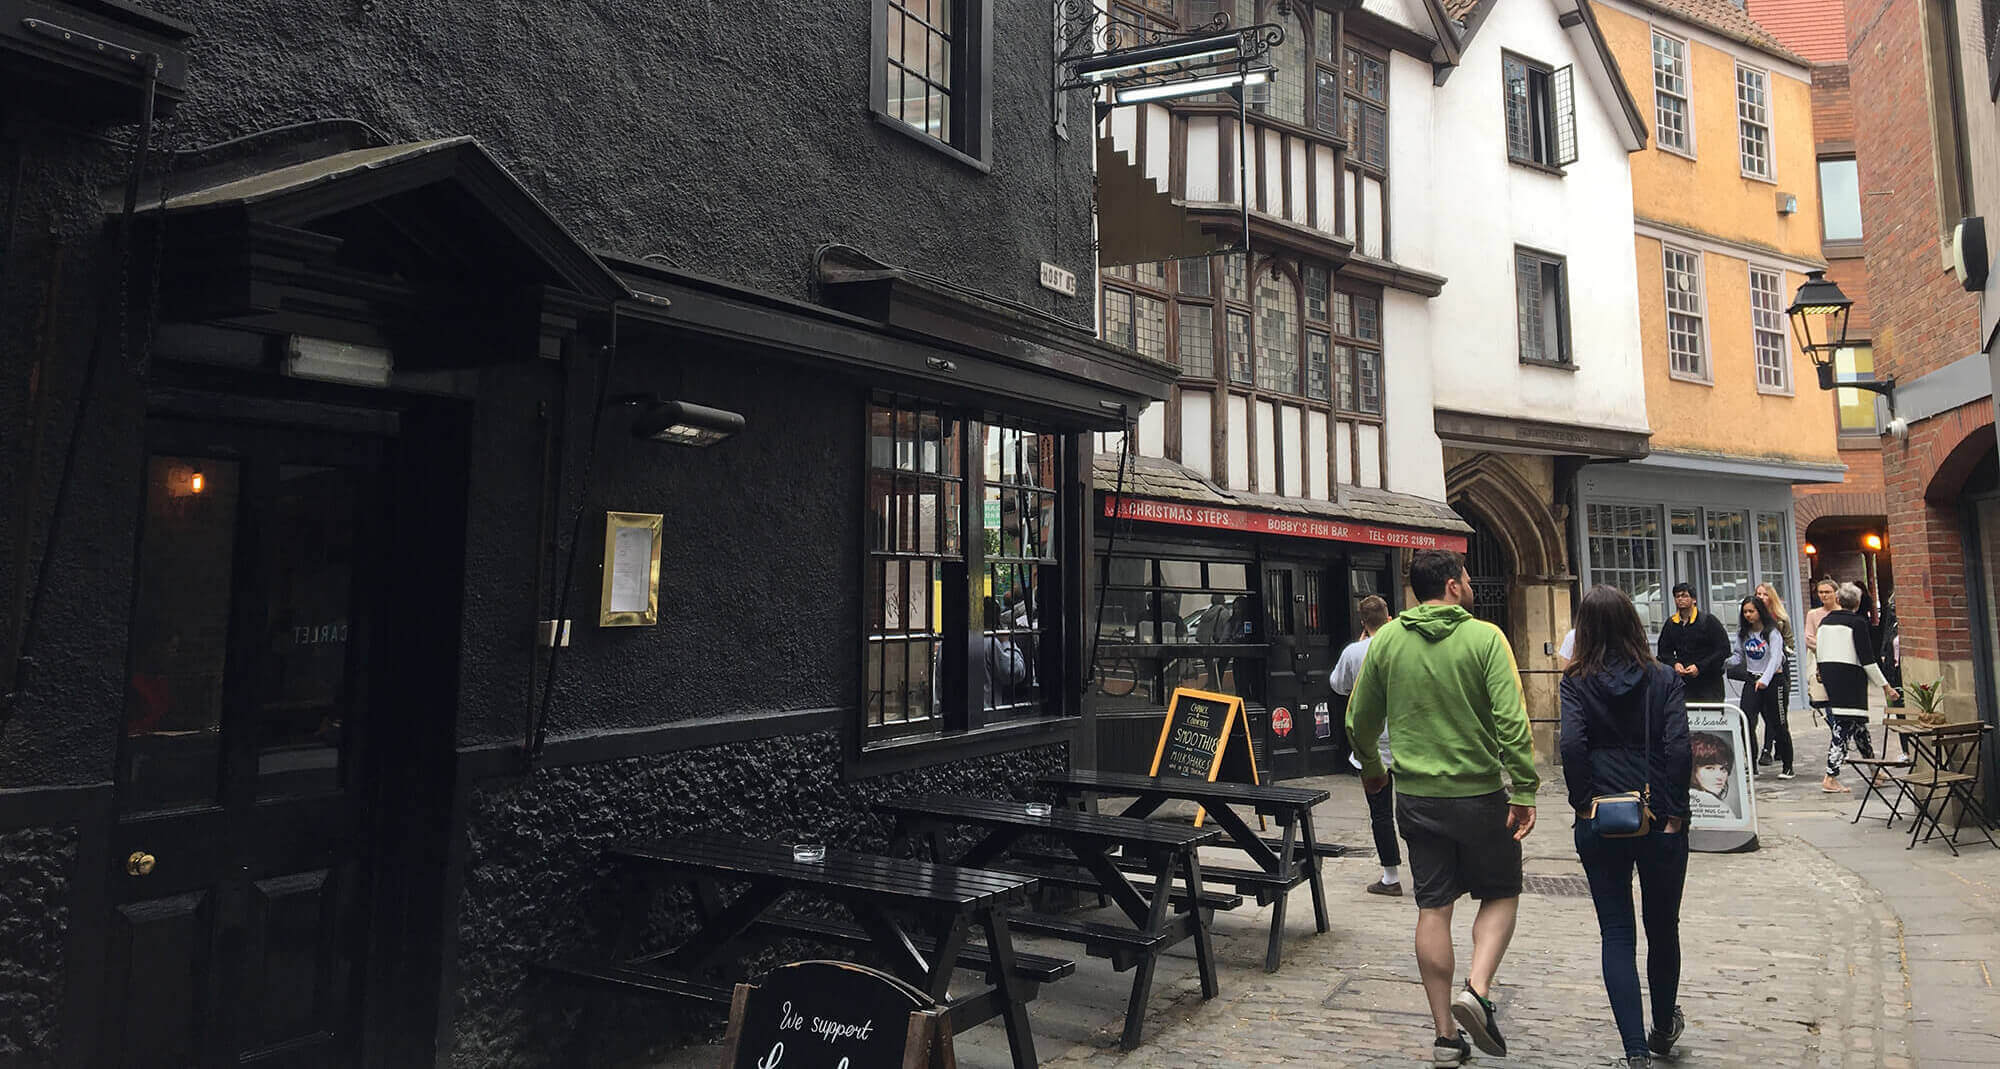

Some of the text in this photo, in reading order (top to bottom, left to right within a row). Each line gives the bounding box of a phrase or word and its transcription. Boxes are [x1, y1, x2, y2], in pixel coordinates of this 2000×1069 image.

[1042, 265, 1063, 287] HOST
[1129, 502, 1193, 521] CHRISTMAS
[1196, 511, 1229, 525] STEPS
[1267, 519, 1308, 534] BOBBY'S
[1310, 523, 1329, 536] FISH
[1331, 526, 1349, 538] BAR
[1368, 530, 1385, 542] TEL:
[1386, 533, 1409, 544] 01275
[779, 1000, 874, 1044] We support
